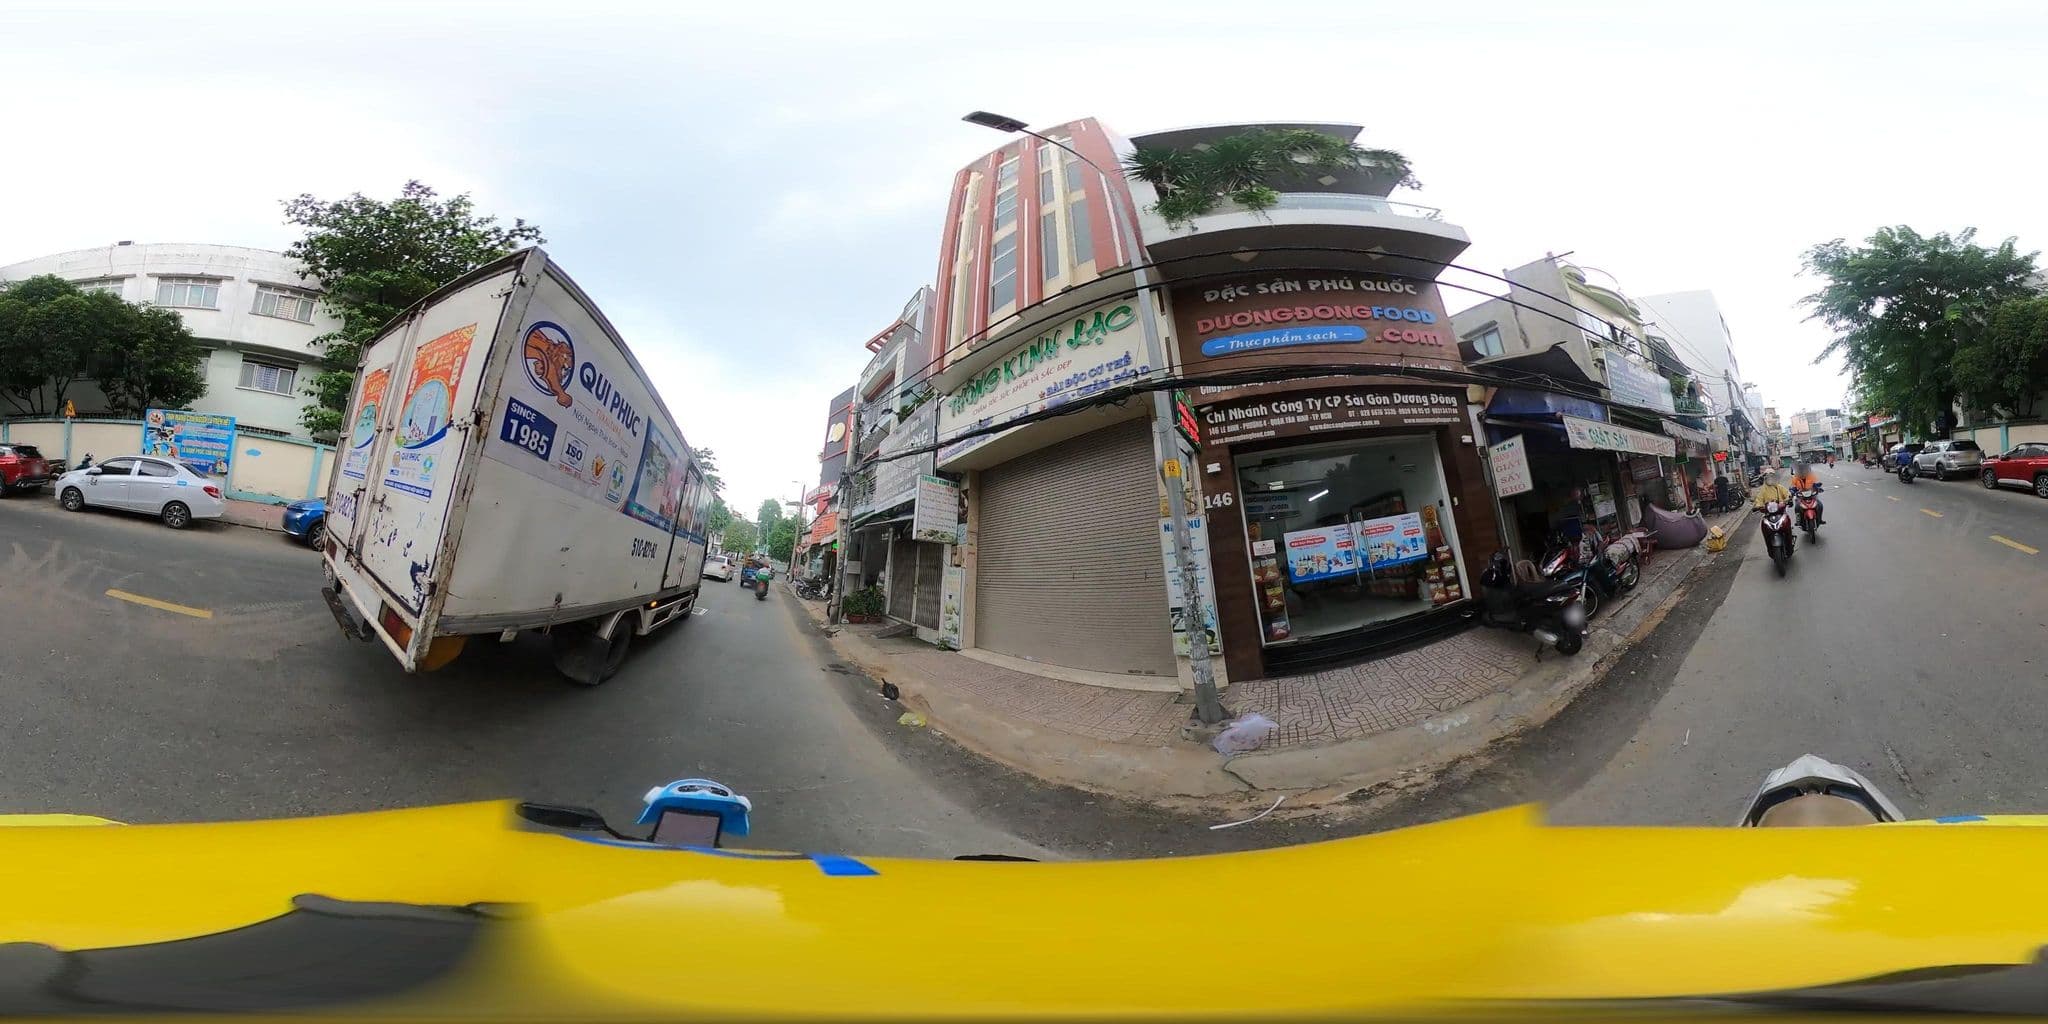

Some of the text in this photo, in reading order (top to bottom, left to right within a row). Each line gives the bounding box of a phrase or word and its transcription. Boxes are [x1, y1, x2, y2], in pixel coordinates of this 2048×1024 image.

[1204, 276, 1417, 302] ĐẶC SẢN PHÚ QUỐC
[1229, 331, 1337, 350] Thực phẩm sạch
[948, 305, 1136, 418] THÔNG KINH LẠC
[1057, 359, 1072, 371] ĐẸP
[1088, 363, 1104, 378] CƠ
[1105, 350, 1132, 372] THỂ
[510, 402, 538, 423] SINCE
[579, 361, 641, 438] QUI PHUC
[1206, 392, 1458, 424] Chi Nhánh Công Ty CP Sài Gòn Dương Đông
[509, 418, 550, 456] 1985
[565, 442, 583, 461] ISO
[1203, 492, 1233, 509] 146
